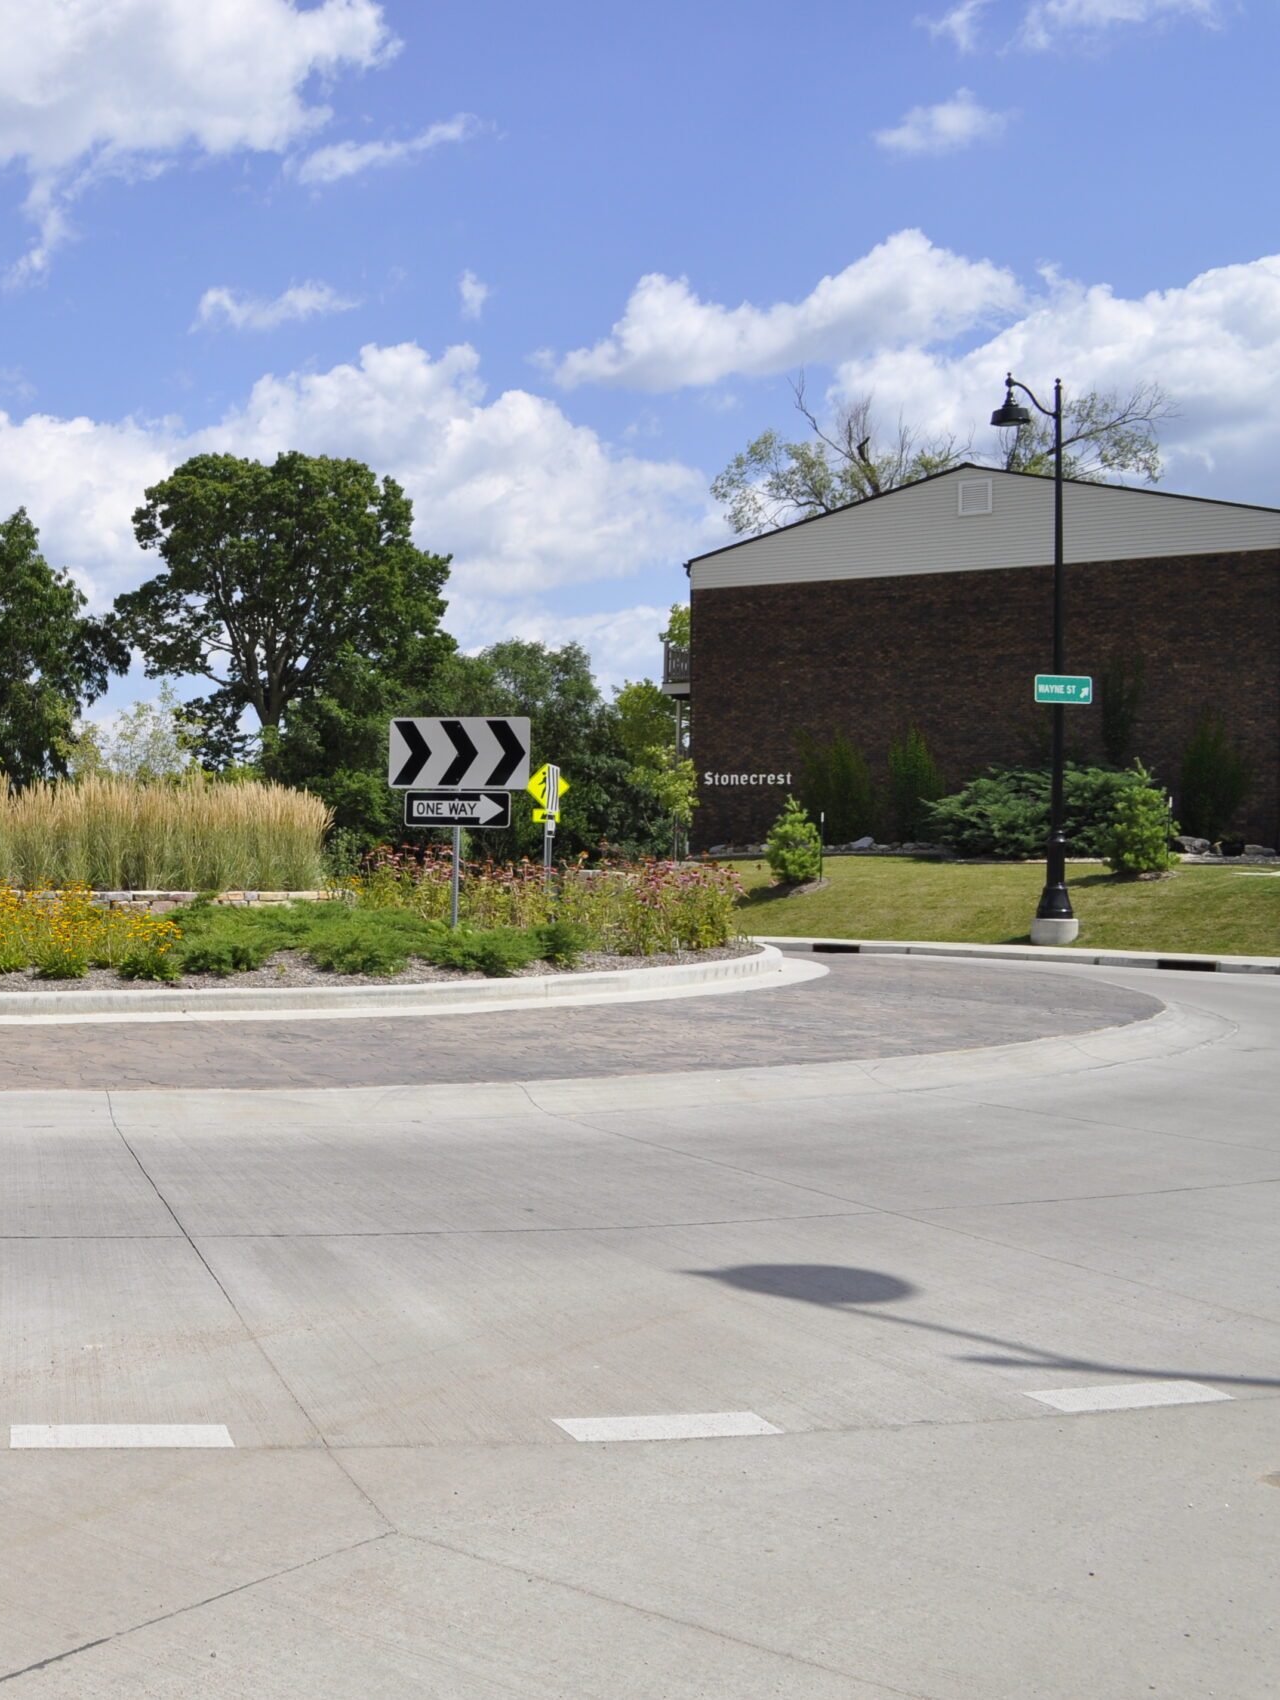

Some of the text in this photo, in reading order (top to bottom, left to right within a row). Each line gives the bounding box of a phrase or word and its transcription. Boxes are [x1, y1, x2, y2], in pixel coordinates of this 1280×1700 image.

[1038, 684, 1076, 695] WAYNE ST
[704, 771, 792, 786] Stonecrest
[416, 802, 477, 816] ONE WAY
